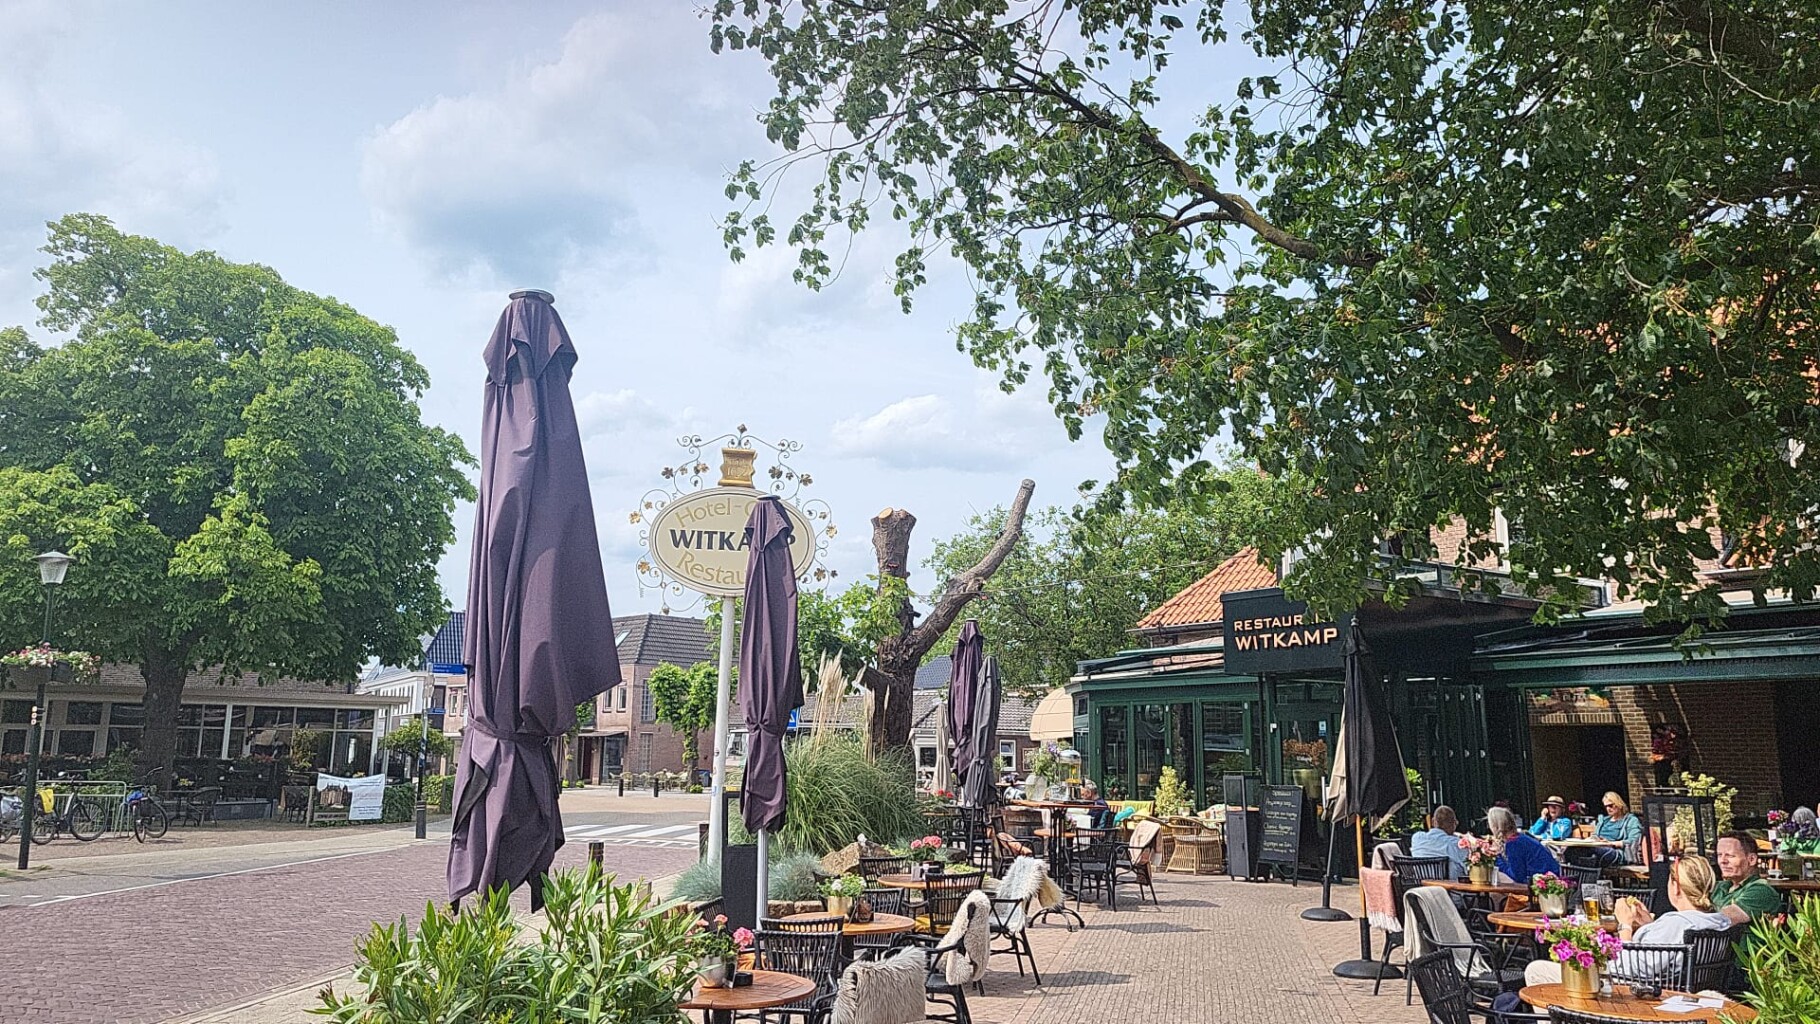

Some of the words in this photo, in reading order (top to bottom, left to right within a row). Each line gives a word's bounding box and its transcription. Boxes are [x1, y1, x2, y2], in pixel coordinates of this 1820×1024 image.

[675, 497, 757, 527] Hotel-C
[669, 529, 796, 551] WITKA
[676, 551, 746, 585] Restau
[1234, 611, 1334, 631] RESTAUR
[1235, 627, 1337, 650] WITKAMP
